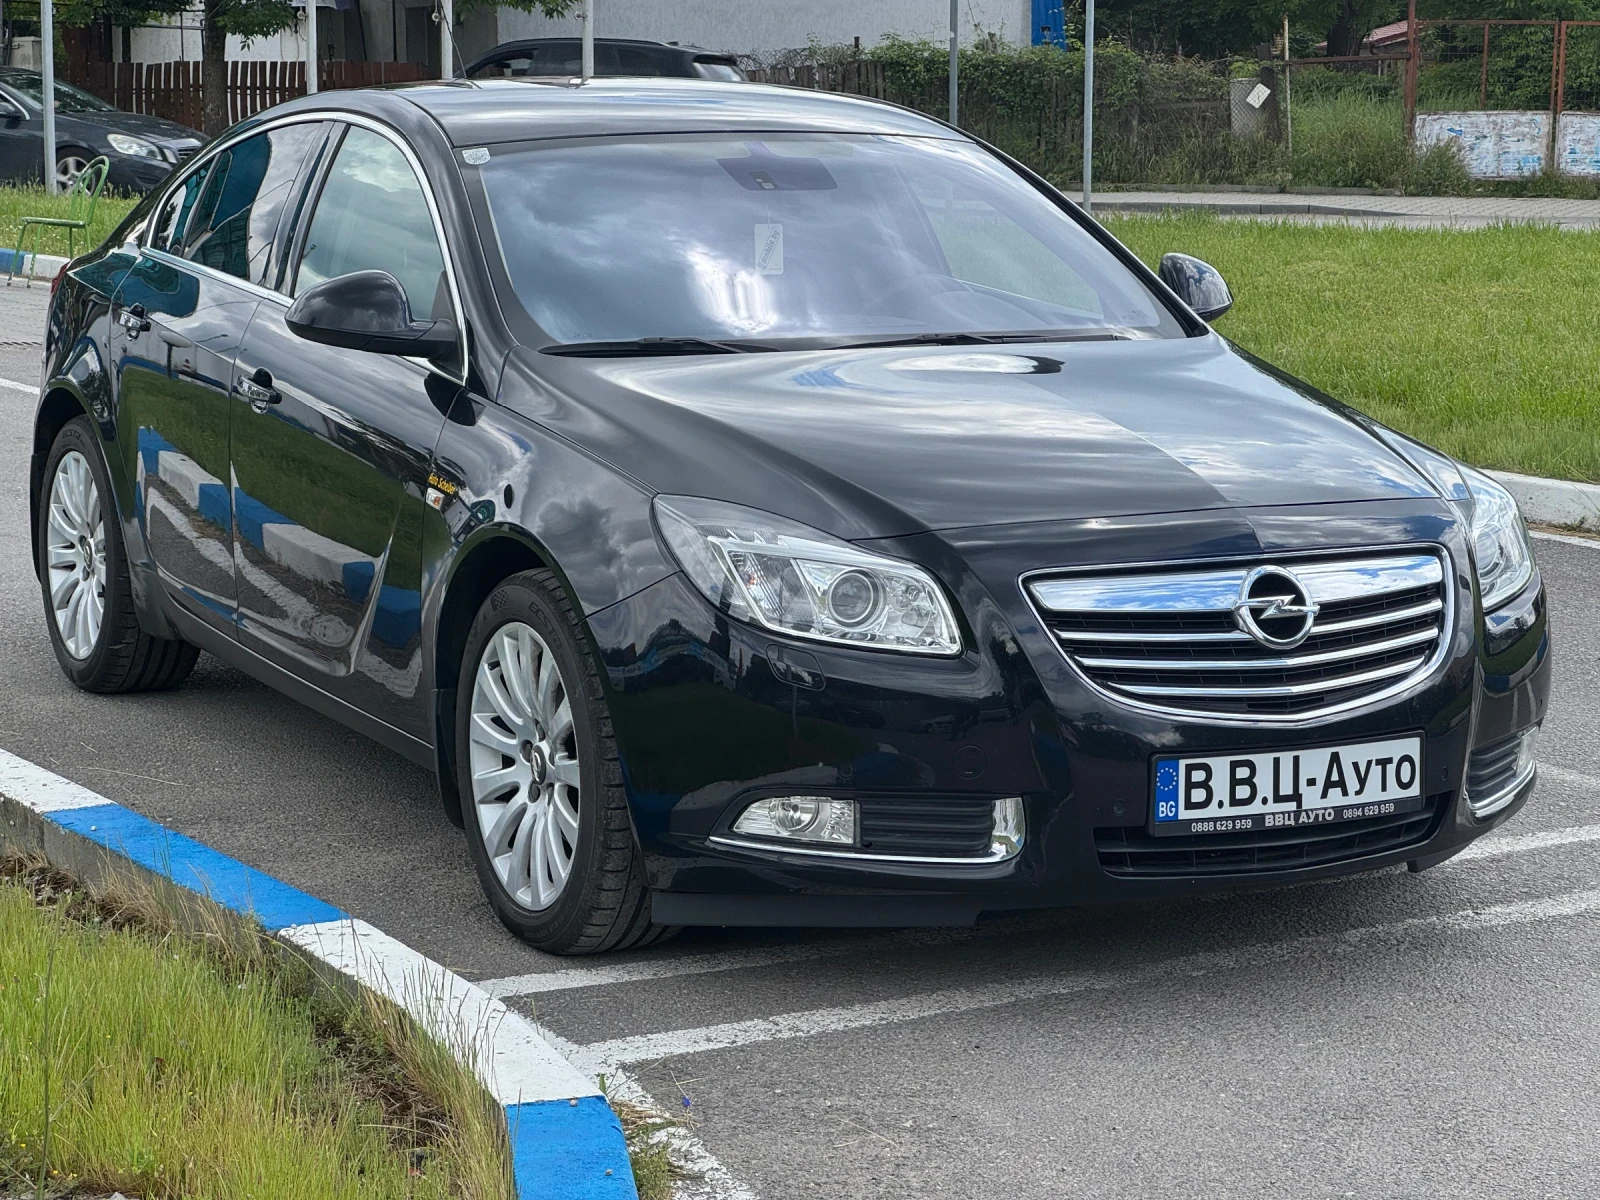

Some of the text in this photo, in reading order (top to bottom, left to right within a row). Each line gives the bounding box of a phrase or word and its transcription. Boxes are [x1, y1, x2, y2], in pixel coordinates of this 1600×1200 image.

[1158, 801, 1176, 817] BG
[1191, 803, 1395, 832] 0888 629 959 ВВЦ АУТО 0894 629 959
